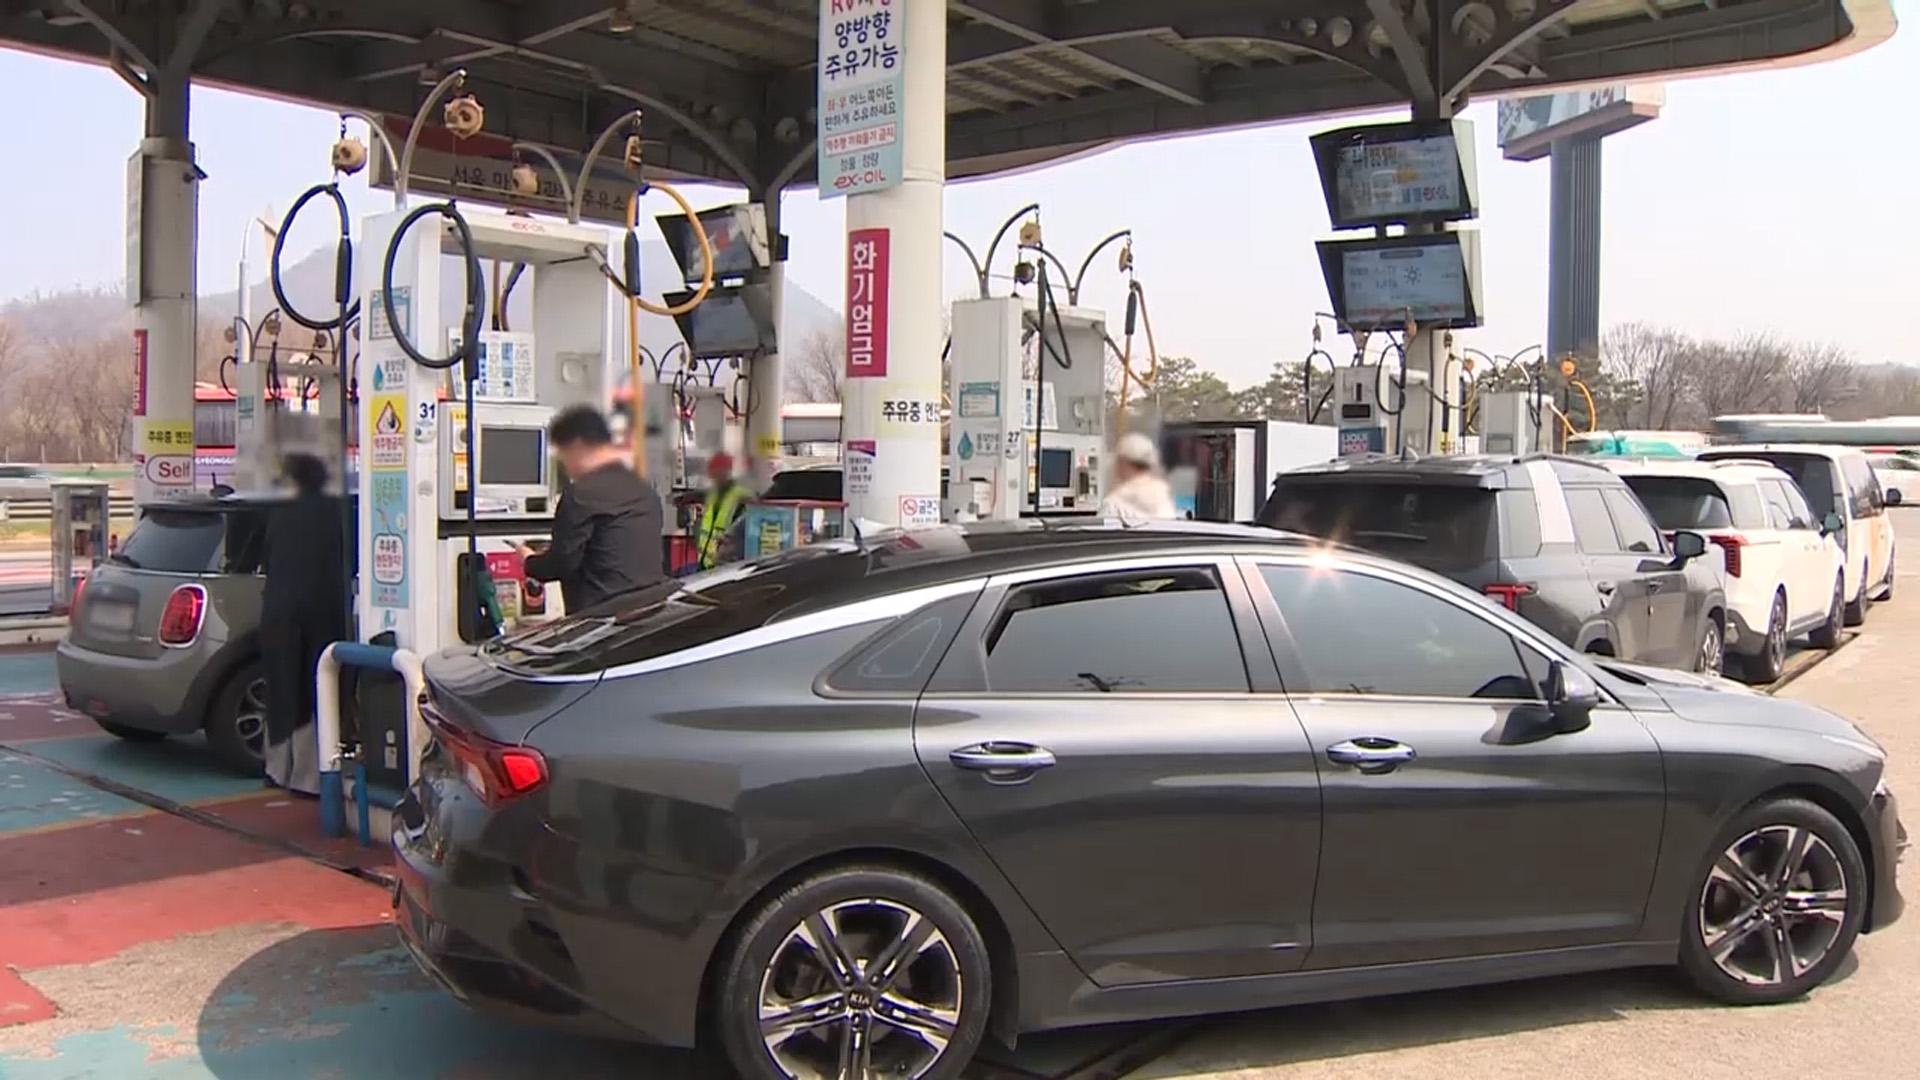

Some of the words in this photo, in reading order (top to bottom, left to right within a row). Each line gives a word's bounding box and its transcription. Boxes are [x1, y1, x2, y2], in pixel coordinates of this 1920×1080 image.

[834, 10, 892, 49] 양방향
[824, 42, 899, 81] 주유가능
[824, 112, 850, 131] 편하게
[852, 101, 897, 122] 주유하세요
[454, 164, 486, 186] 서울
[851, 240, 877, 366] 화기엄금
[419, 402, 436, 419] 31
[882, 401, 921, 423] 주유중
[148, 430, 173, 444] 주유중
[1008, 431, 1021, 443] 27
[158, 461, 191, 478] Self
[849, 993, 870, 1004] KIA
